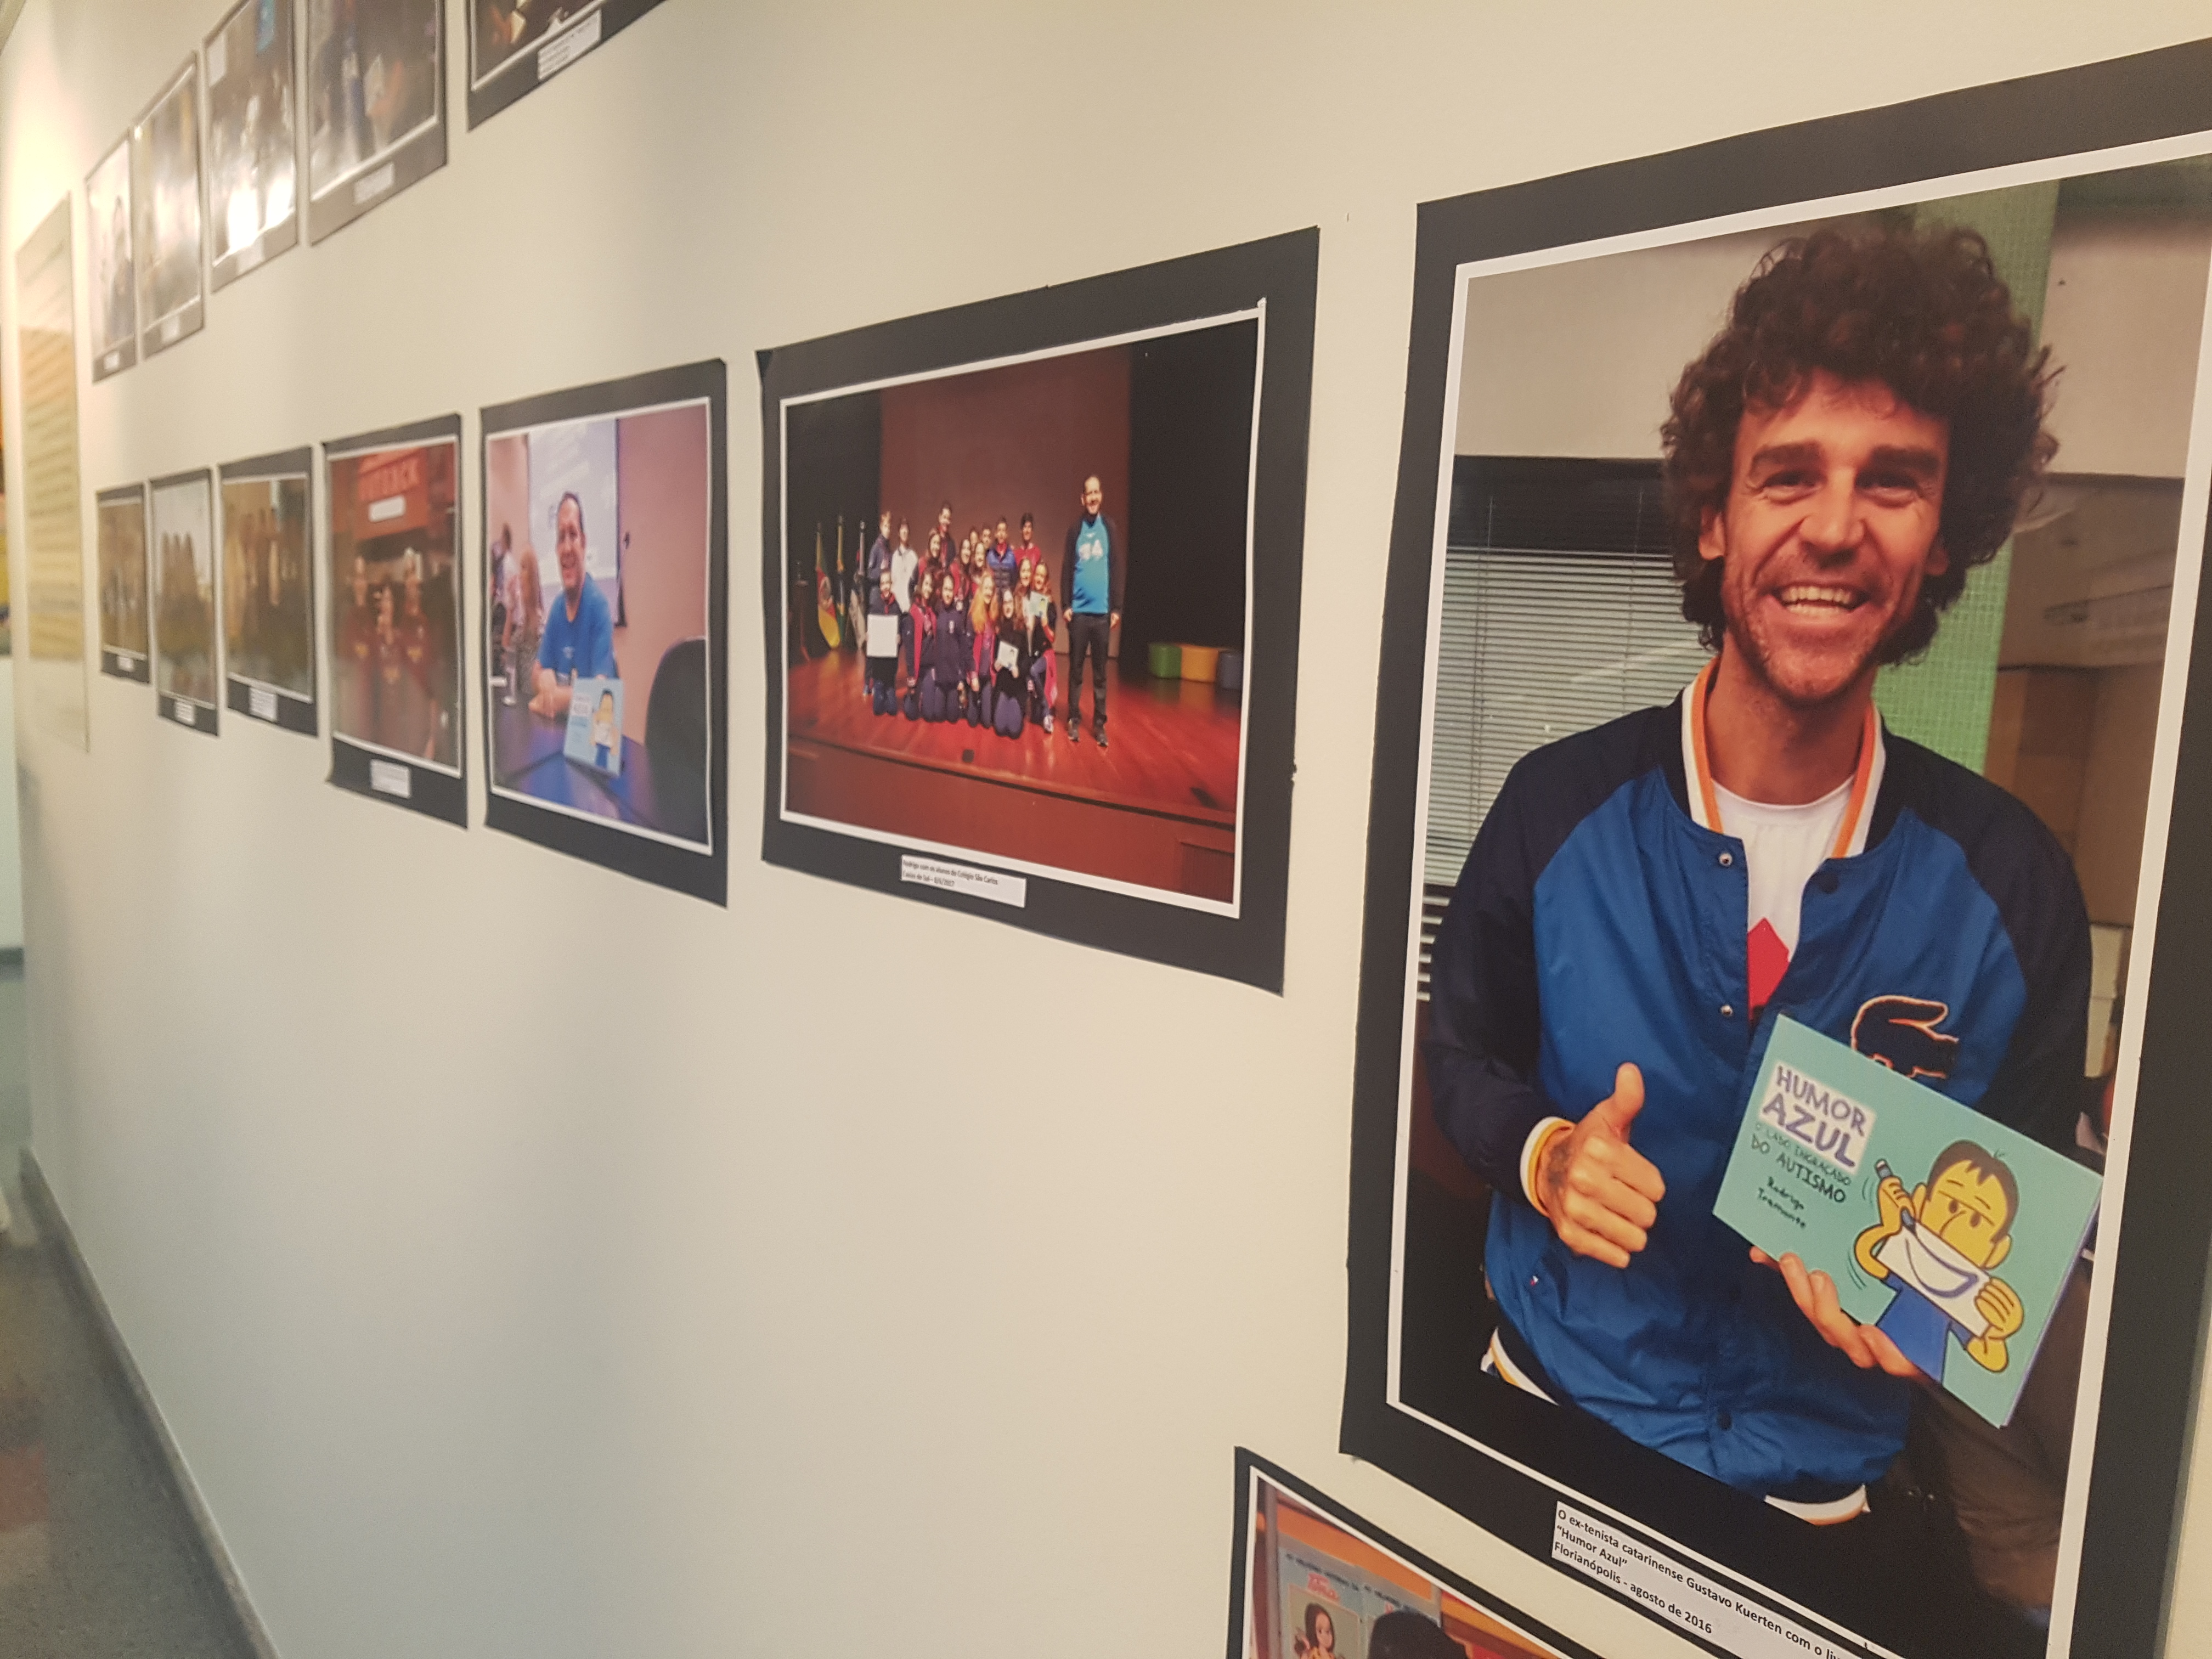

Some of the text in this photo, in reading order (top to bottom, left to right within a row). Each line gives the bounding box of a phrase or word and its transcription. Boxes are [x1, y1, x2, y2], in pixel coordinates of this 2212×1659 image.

[1763, 1093, 1855, 1167] AZUL
[1776, 1065, 1866, 1137] HUMOR
[1751, 1132, 1846, 1203] DO AUTISMO
[1554, 1542, 1621, 1584] Florianópolis
[1630, 1583, 1665, 1608] agosto
[1668, 1603, 1681, 1617] de
[1684, 1611, 1712, 1634] 2016
[1558, 1509, 1566, 1520] O
[1569, 1516, 1618, 1548] ex-tenista
[1622, 1544, 1683, 1582] catarinense
[1686, 1577, 1732, 1607] Gustavo
[1736, 1602, 1782, 1634] Kuerten
[1785, 1630, 1810, 1650] com
[1814, 1646, 1822, 1656] o
